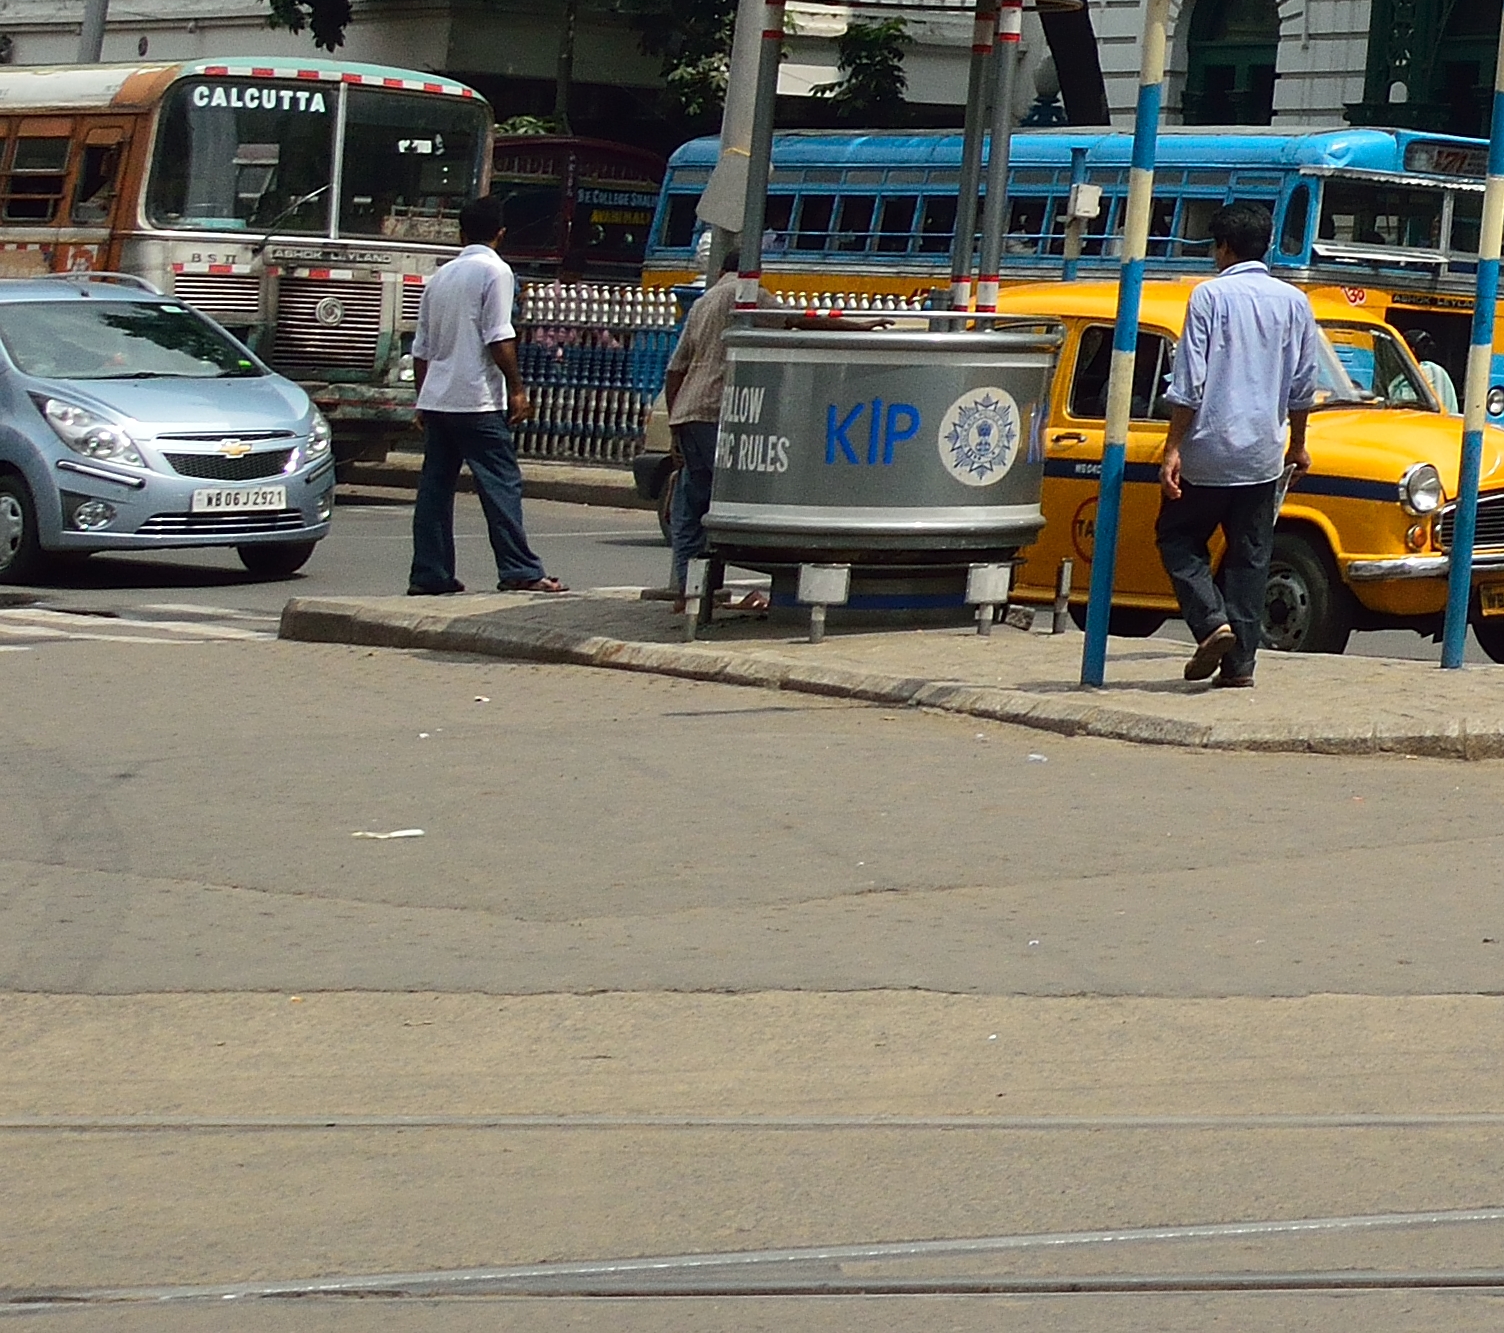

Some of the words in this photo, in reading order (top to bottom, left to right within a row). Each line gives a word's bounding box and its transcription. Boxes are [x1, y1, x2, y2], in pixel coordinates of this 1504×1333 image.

[193, 85, 326, 113] CALCUTTA
[824, 396, 922, 466] KIP
[737, 433, 791, 473] RULES
